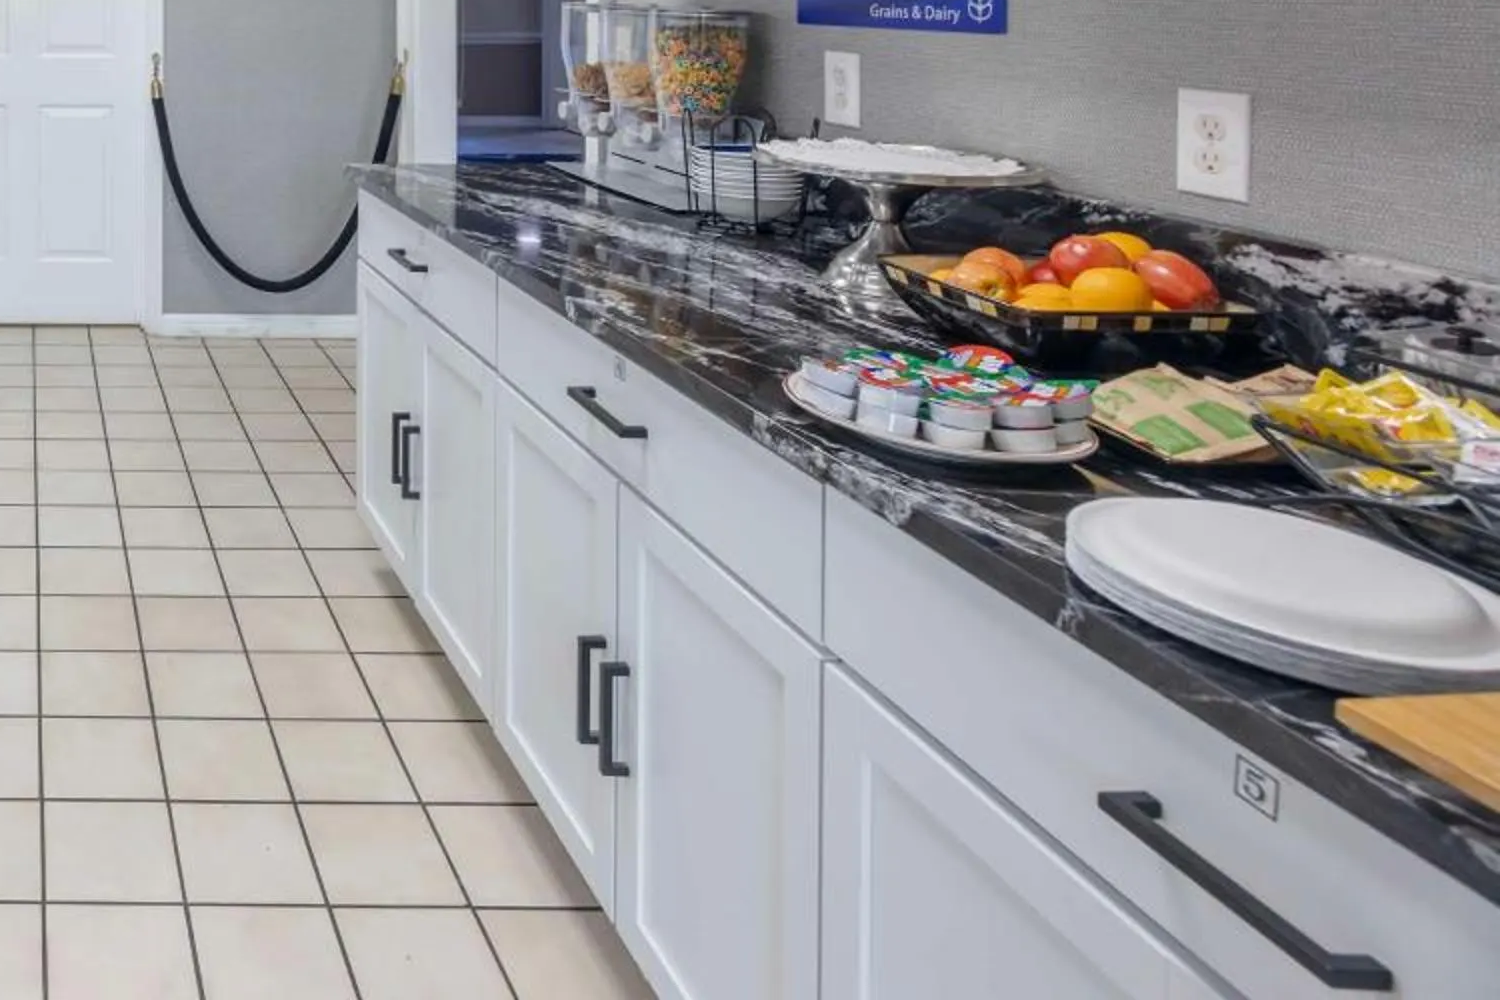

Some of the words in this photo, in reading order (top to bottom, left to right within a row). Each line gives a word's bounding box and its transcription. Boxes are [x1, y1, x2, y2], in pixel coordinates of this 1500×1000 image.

[869, 3, 909, 19] Grains
[911, 5, 921, 19] &
[924, 5, 961, 25] Dairy
[1243, 768, 1266, 802] 5
